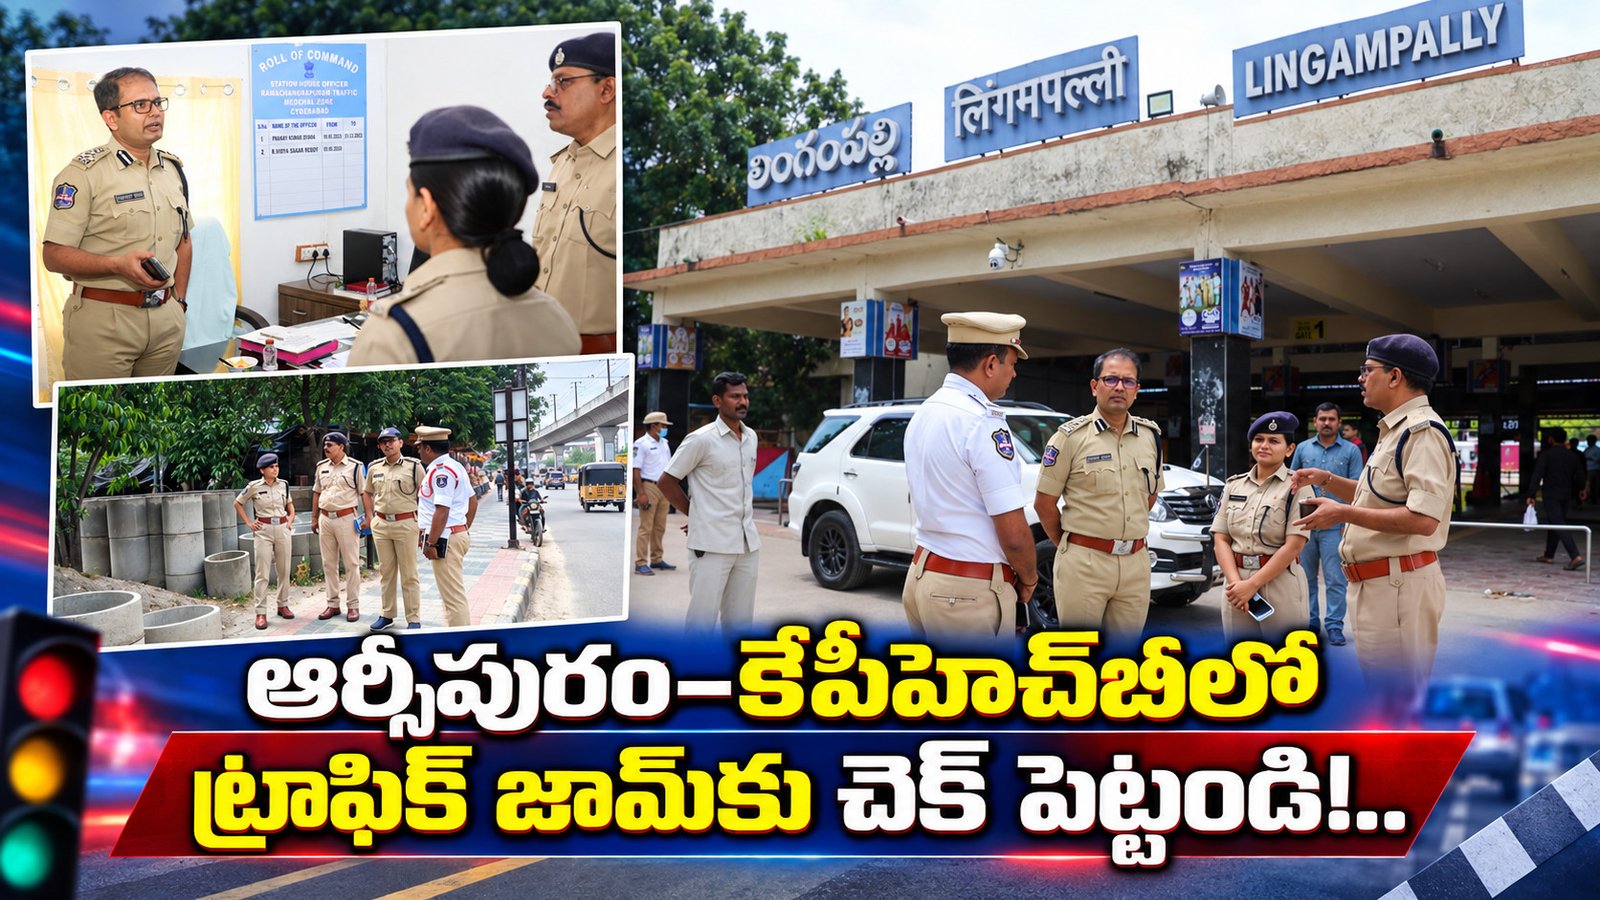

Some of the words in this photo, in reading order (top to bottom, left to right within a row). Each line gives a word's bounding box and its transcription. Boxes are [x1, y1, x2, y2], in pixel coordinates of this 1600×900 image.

[258, 53, 287, 73] ROLL
[290, 50, 303, 61] OF
[307, 49, 359, 74] COMMAND
[1245, 3, 1505, 98] LINGAMPALLY
[951, 45, 1129, 139] लिंगमपल्ली
[747, 116, 901, 190] లింగంపల్లి
[1314, 320, 1324, 338] 1
